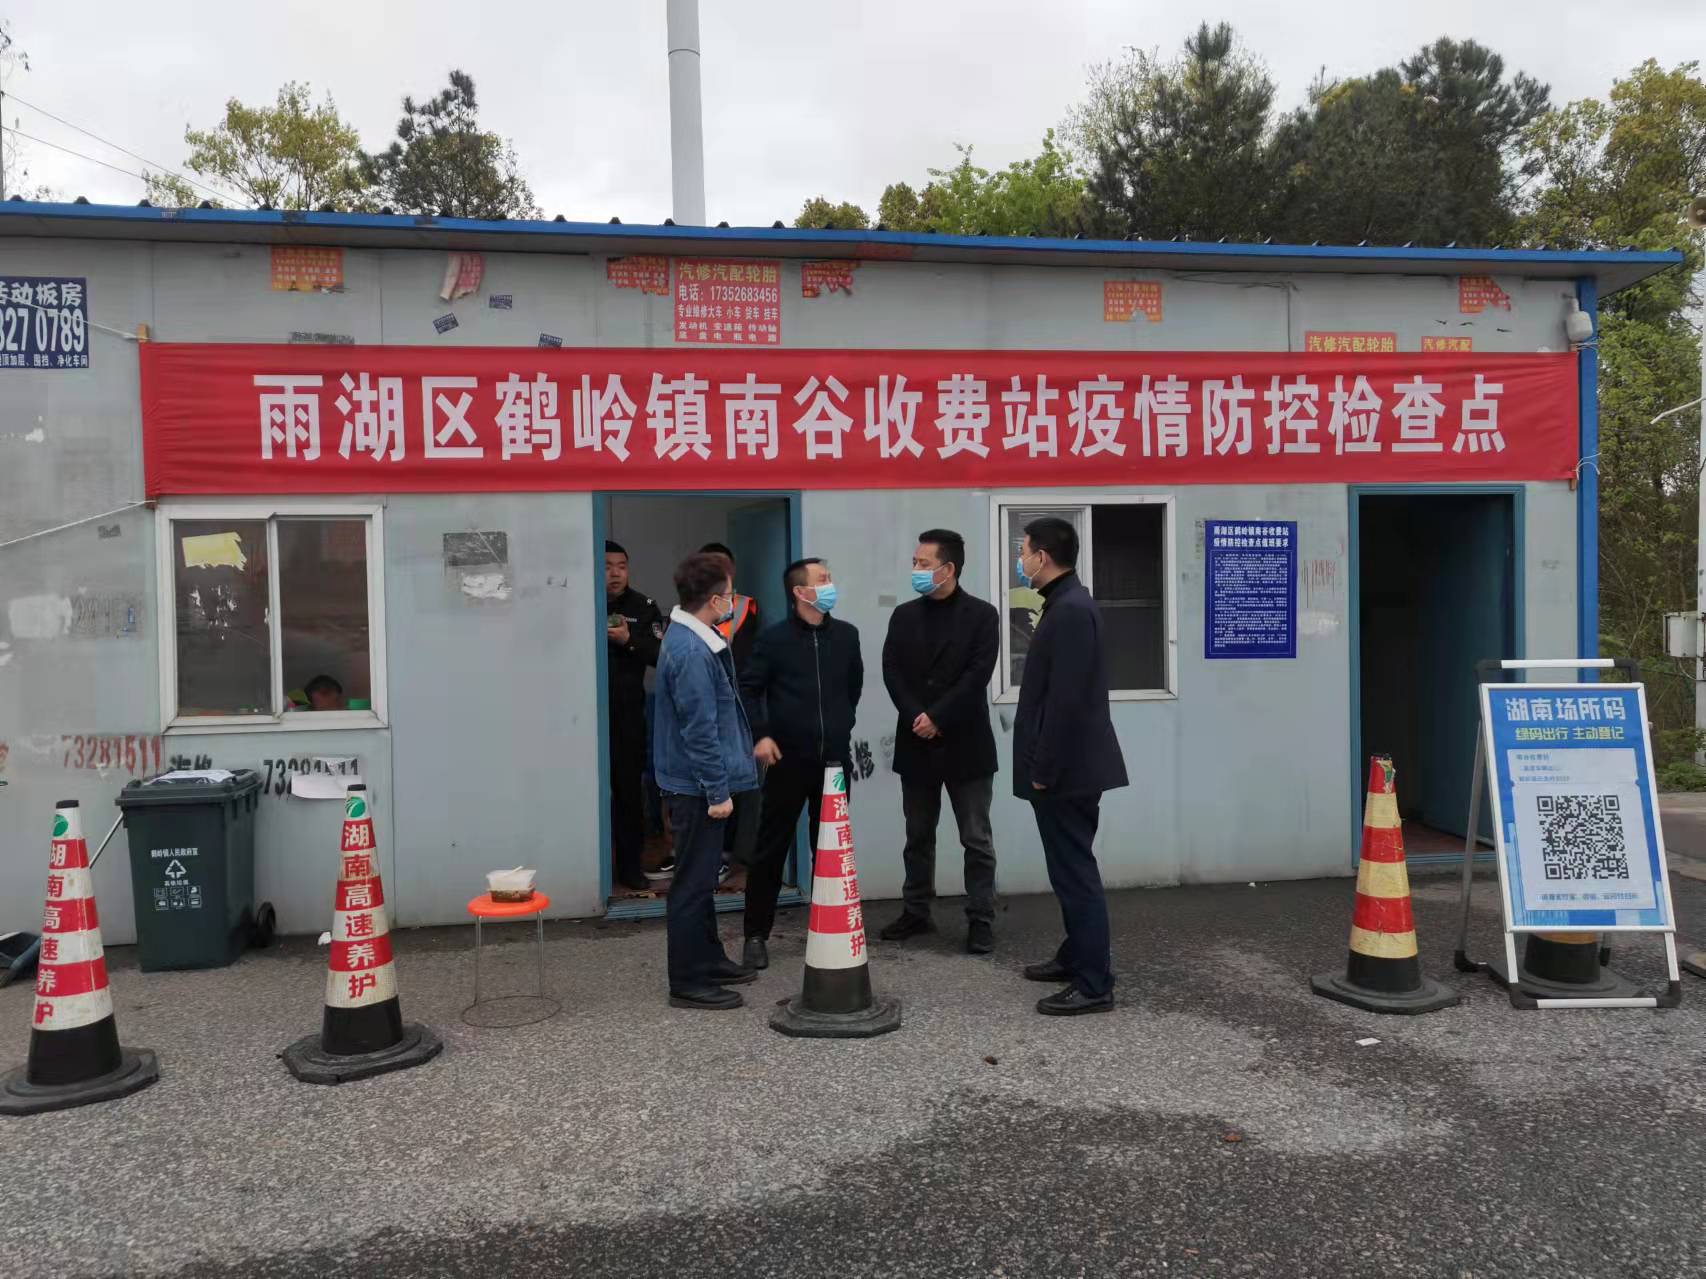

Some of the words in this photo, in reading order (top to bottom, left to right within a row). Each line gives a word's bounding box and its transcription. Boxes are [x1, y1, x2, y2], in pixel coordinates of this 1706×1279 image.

[679, 262, 778, 283] 汽修汽配轮胎
[710, 285, 778, 303] 17352683456
[678, 304, 723, 319] 专业维修大车
[726, 306, 742, 319] 小车
[745, 306, 760, 320] 货车
[35, 308, 85, 352] 0789
[1308, 335, 1394, 352] 汽修汽配轮胎
[1423, 338, 1472, 351] 汽修汽配
[252, 371, 1507, 463] 雨湖区鹤岭镇南谷收费站疫情防控检查点
[1505, 697, 1626, 721] 湖南场所码
[1515, 727, 1568, 741] 绿码出行
[1573, 726, 1625, 740] 主动登记
[343, 823, 377, 999] 湖南高速养护
